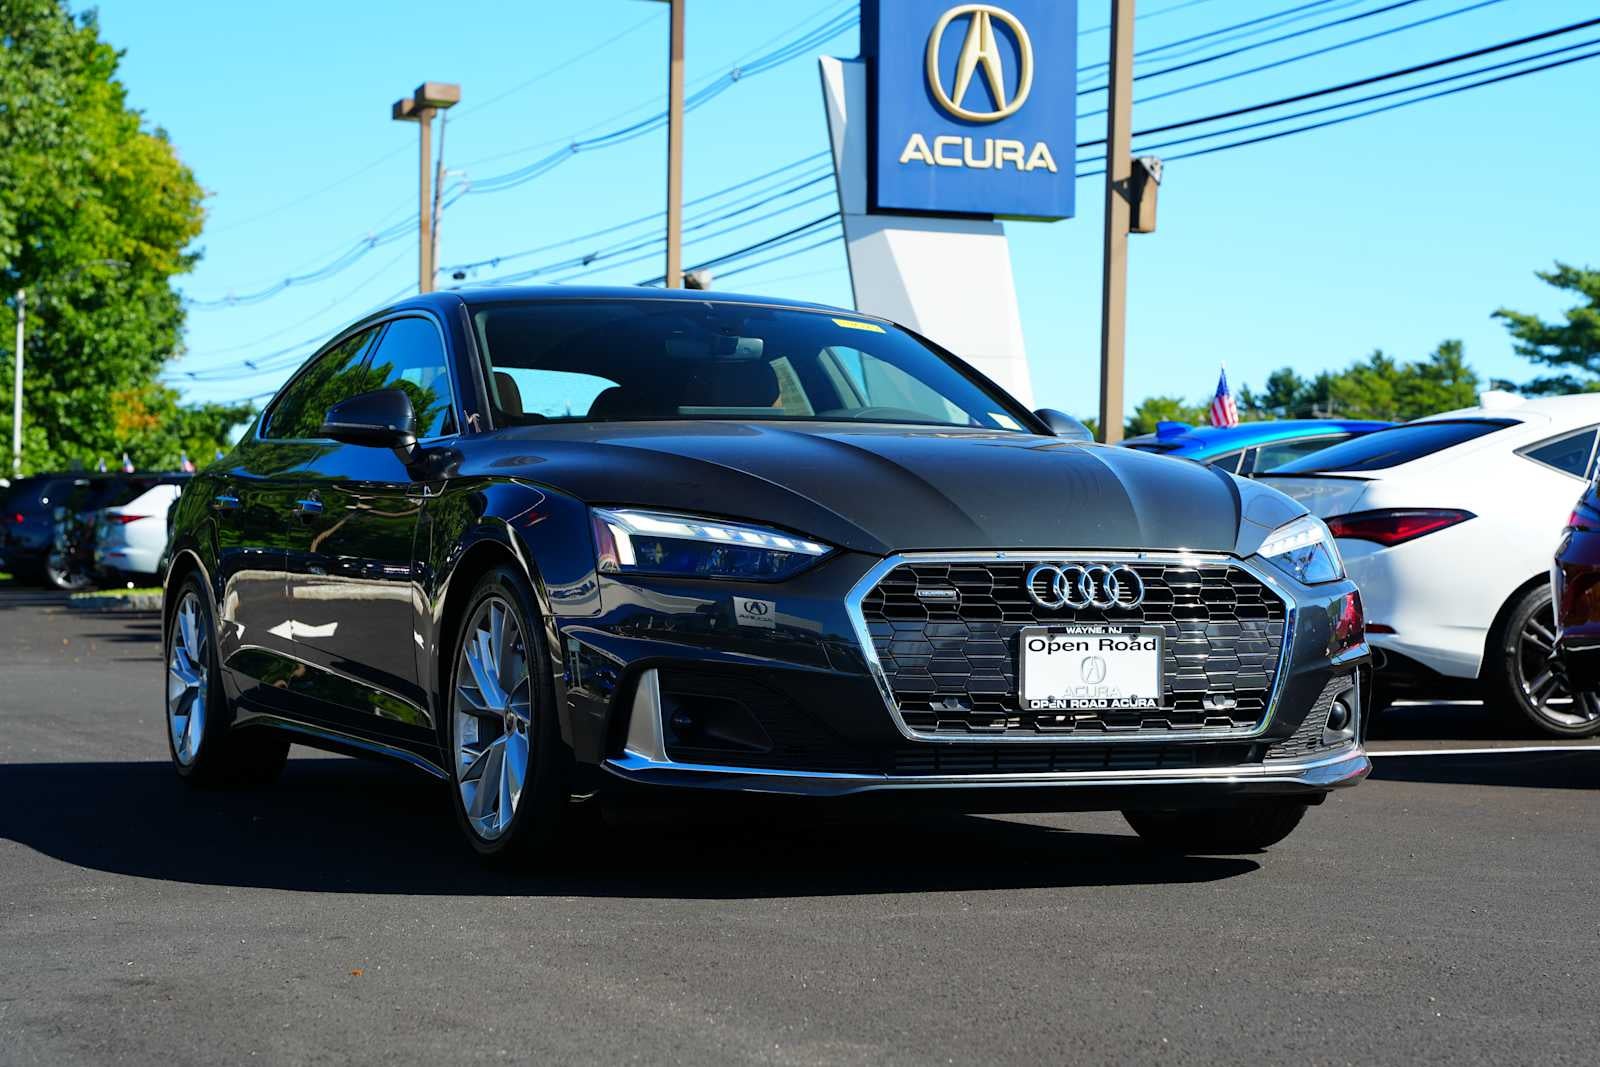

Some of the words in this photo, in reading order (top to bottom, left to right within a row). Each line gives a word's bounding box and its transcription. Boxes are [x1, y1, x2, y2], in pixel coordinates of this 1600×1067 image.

[899, 133, 1058, 173] ACURA
[1108, 626, 1122, 634] NJ
[1028, 639, 1089, 655] Open
[1099, 638, 1156, 651] Road
[1063, 686, 1121, 698] ACURA
[1030, 700, 1066, 709] OPEN
[1071, 700, 1107, 709] ROAD
[1111, 699, 1156, 708] ACURA
